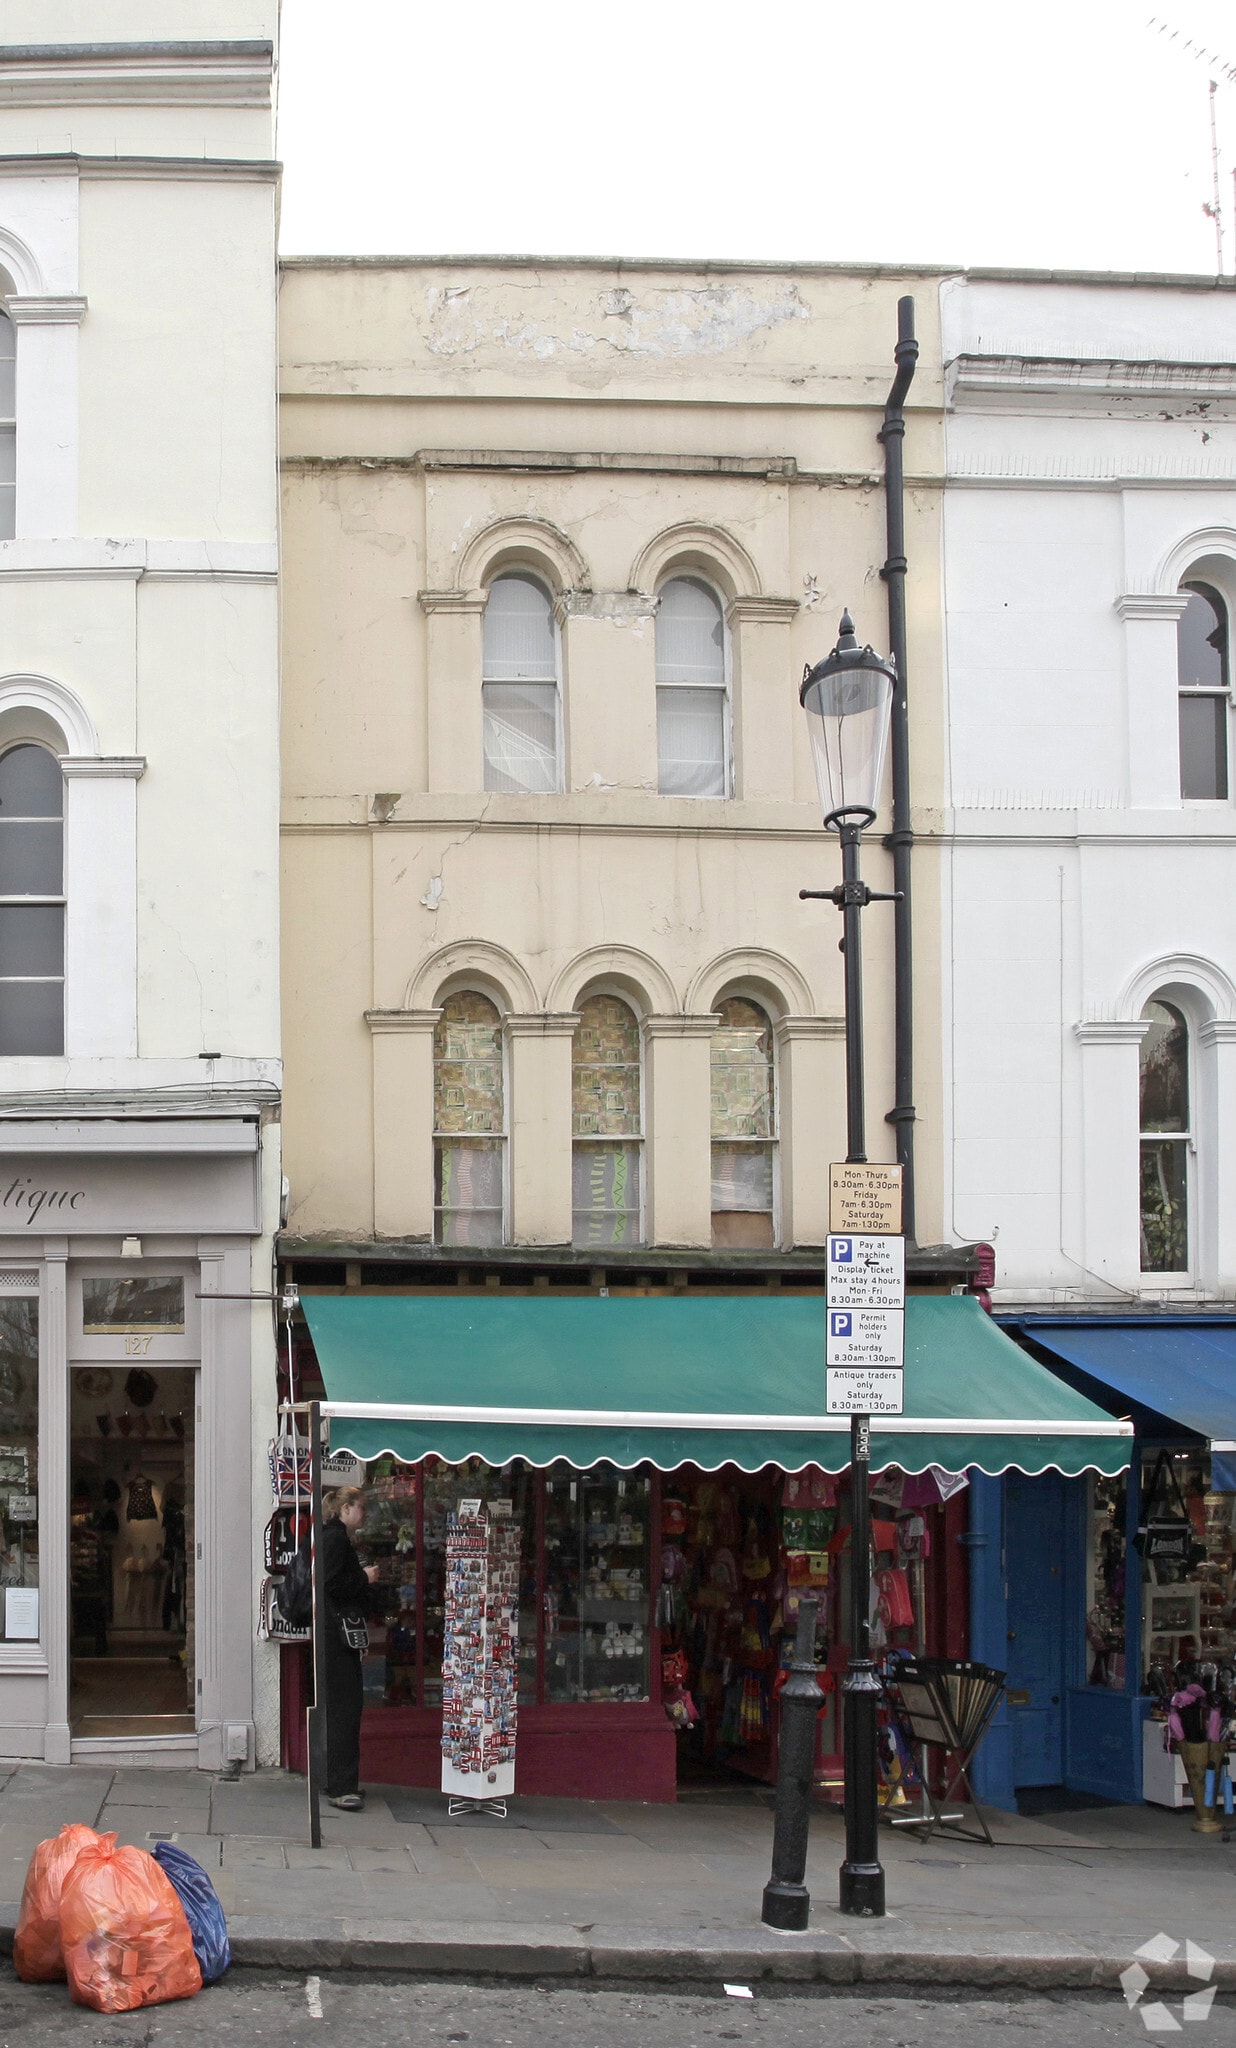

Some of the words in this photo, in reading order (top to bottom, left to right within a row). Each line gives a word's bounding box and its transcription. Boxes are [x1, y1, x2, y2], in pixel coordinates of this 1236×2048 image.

[853, 1190, 878, 1200] Friday
[0, 1178, 86, 1225] tique
[848, 1210, 884, 1219] Saturday
[859, 1240, 874, 1249] Pay
[835, 1240, 848, 1260] P
[838, 1265, 867, 1274] Display
[870, 1266, 894, 1274] ticket
[831, 1276, 848, 1284] Max
[851, 1277, 868, 1285] stay
[878, 1277, 901, 1285] hours
[835, 1315, 848, 1334] P
[865, 1332, 881, 1340] only
[125, 1335, 153, 1355] 127
[848, 1344, 882, 1352] Saturday
[833, 1371, 865, 1380] Antique
[857, 1381, 873, 1389] only
[847, 1391, 883, 1400] Saturday
[276, 1446, 310, 1457] LONON
[1150, 1537, 1184, 1551] LONDON
